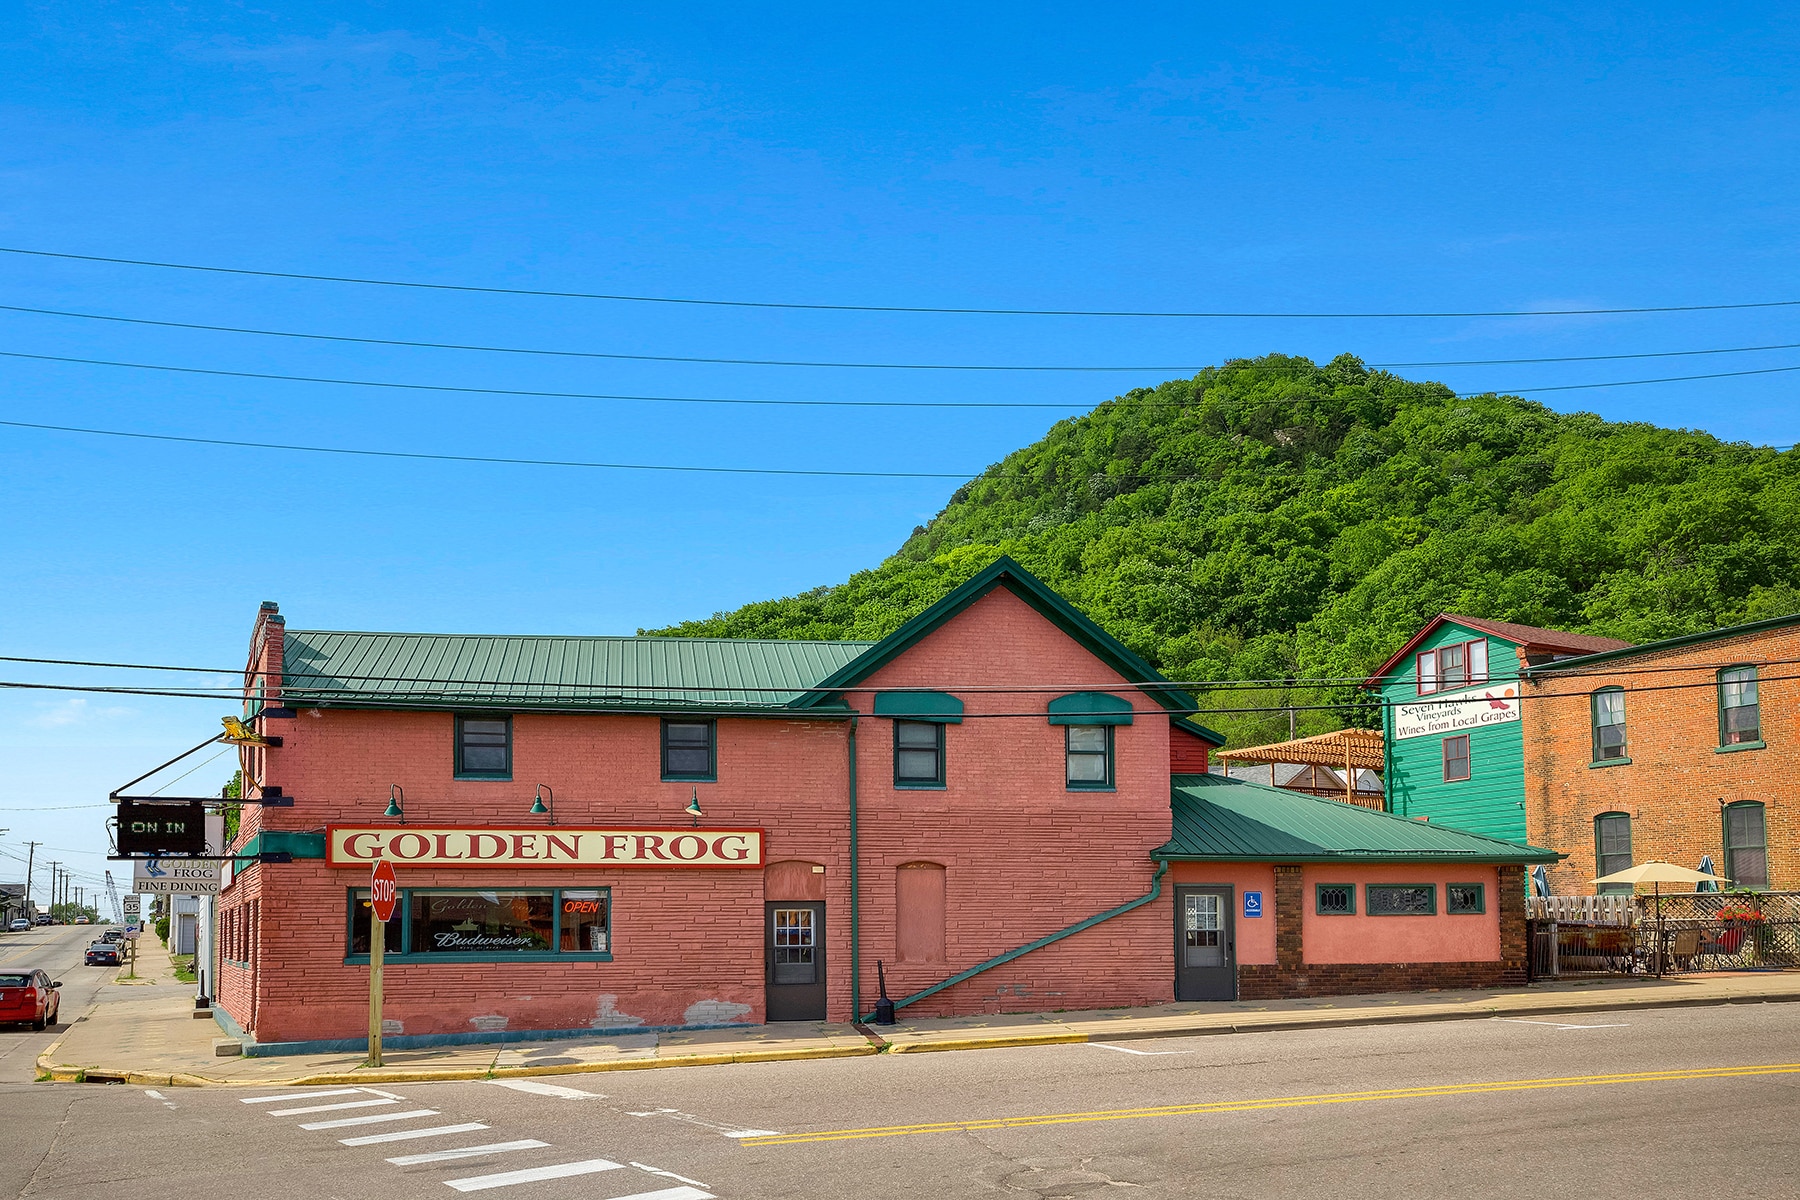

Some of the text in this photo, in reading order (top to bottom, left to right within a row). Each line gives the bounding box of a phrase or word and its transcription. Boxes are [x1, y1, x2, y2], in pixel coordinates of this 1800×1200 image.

[1401, 703, 1434, 716] Seven
[1416, 706, 1462, 721] Vineyards
[1399, 710, 1517, 736] Wines from Local Grapes
[131, 821, 185, 833] ON IN
[343, 833, 750, 860] GOLDEN FROG
[160, 859, 219, 870] GOLDEN
[173, 869, 213, 878] FROG
[138, 881, 218, 892] FINE DINING
[373, 878, 395, 902] STOP
[126, 903, 139, 911] 35
[431, 898, 488, 913] Golden
[564, 901, 600, 913] OPEN
[433, 932, 531, 947] Budweiser
